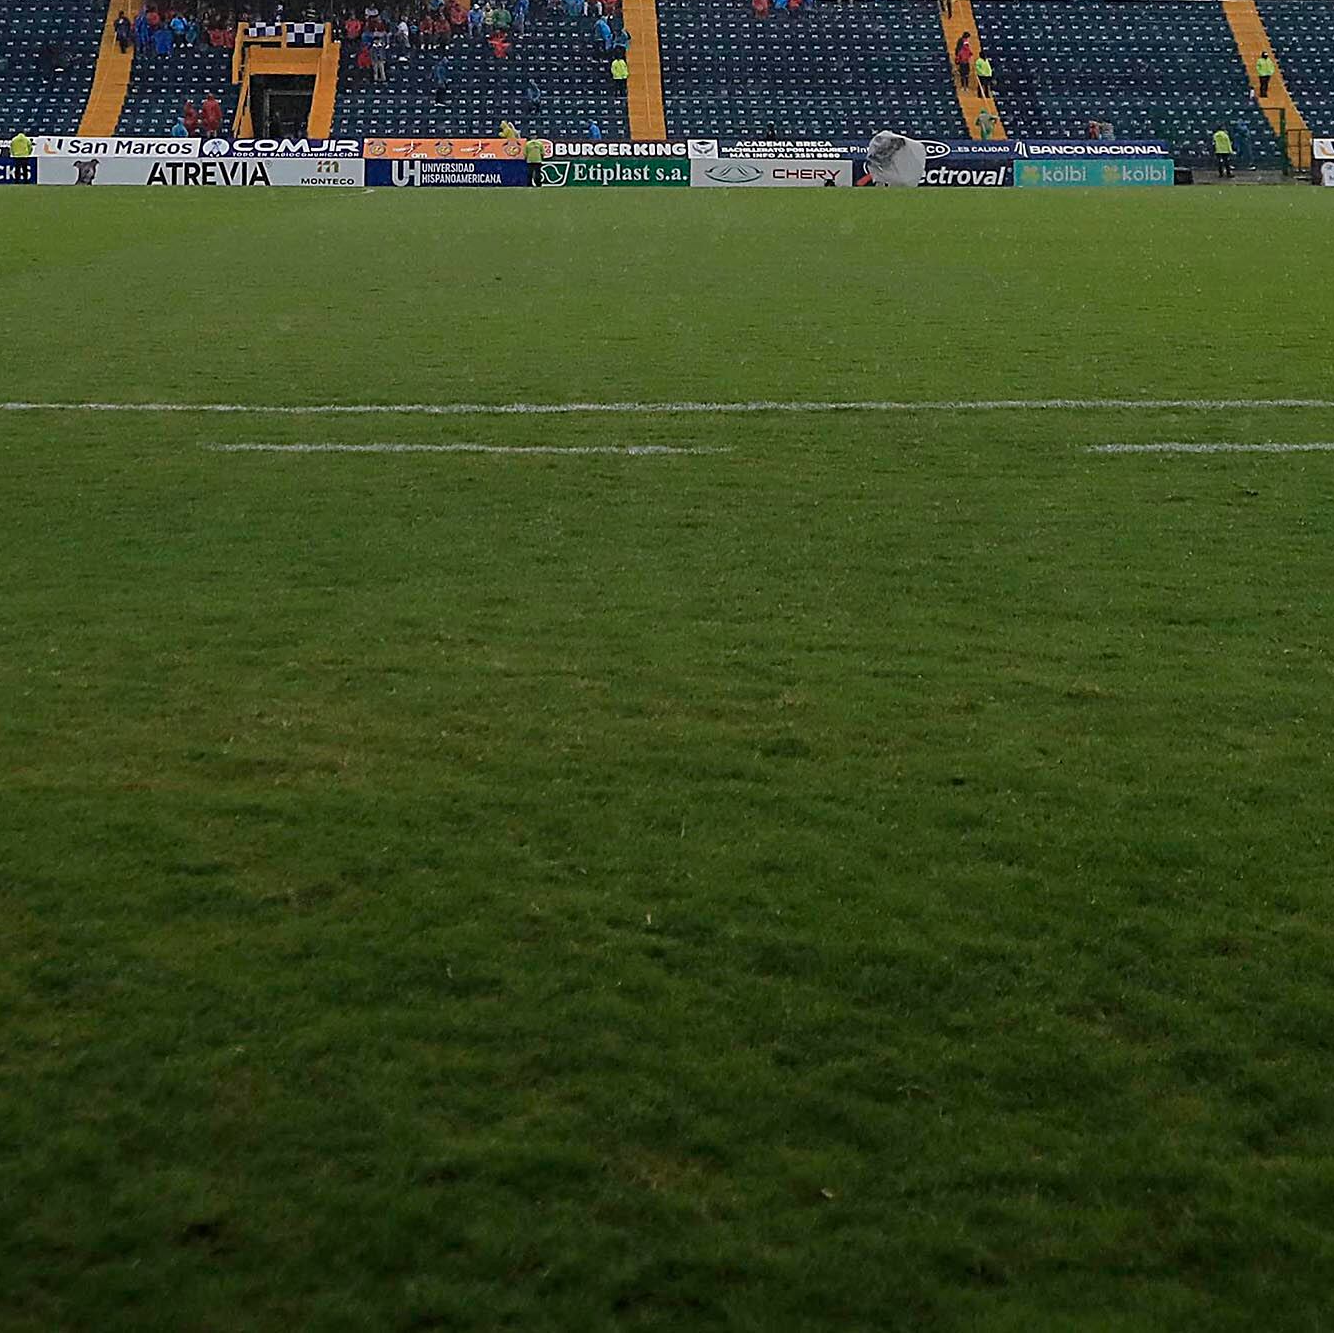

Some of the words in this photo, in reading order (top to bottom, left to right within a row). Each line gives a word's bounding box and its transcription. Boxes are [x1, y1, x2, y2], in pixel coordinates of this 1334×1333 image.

[69, 140, 112, 154] San
[115, 140, 192, 155] Marcos
[232, 139, 359, 152] COMJIR
[1030, 146, 1086, 154] BANCO
[1087, 146, 1169, 155] NACIONAL
[147, 162, 270, 186] ATREVIA
[422, 163, 474, 173] UNIVERSIDAD
[573, 163, 652, 185] Etiplast
[656, 166, 688, 181] s.a.
[773, 169, 841, 180] CHERY
[1042, 162, 1086, 182] kölbi
[1122, 162, 1166, 182] kölbi
[422, 173, 501, 184] HISPANOAMERICANA
